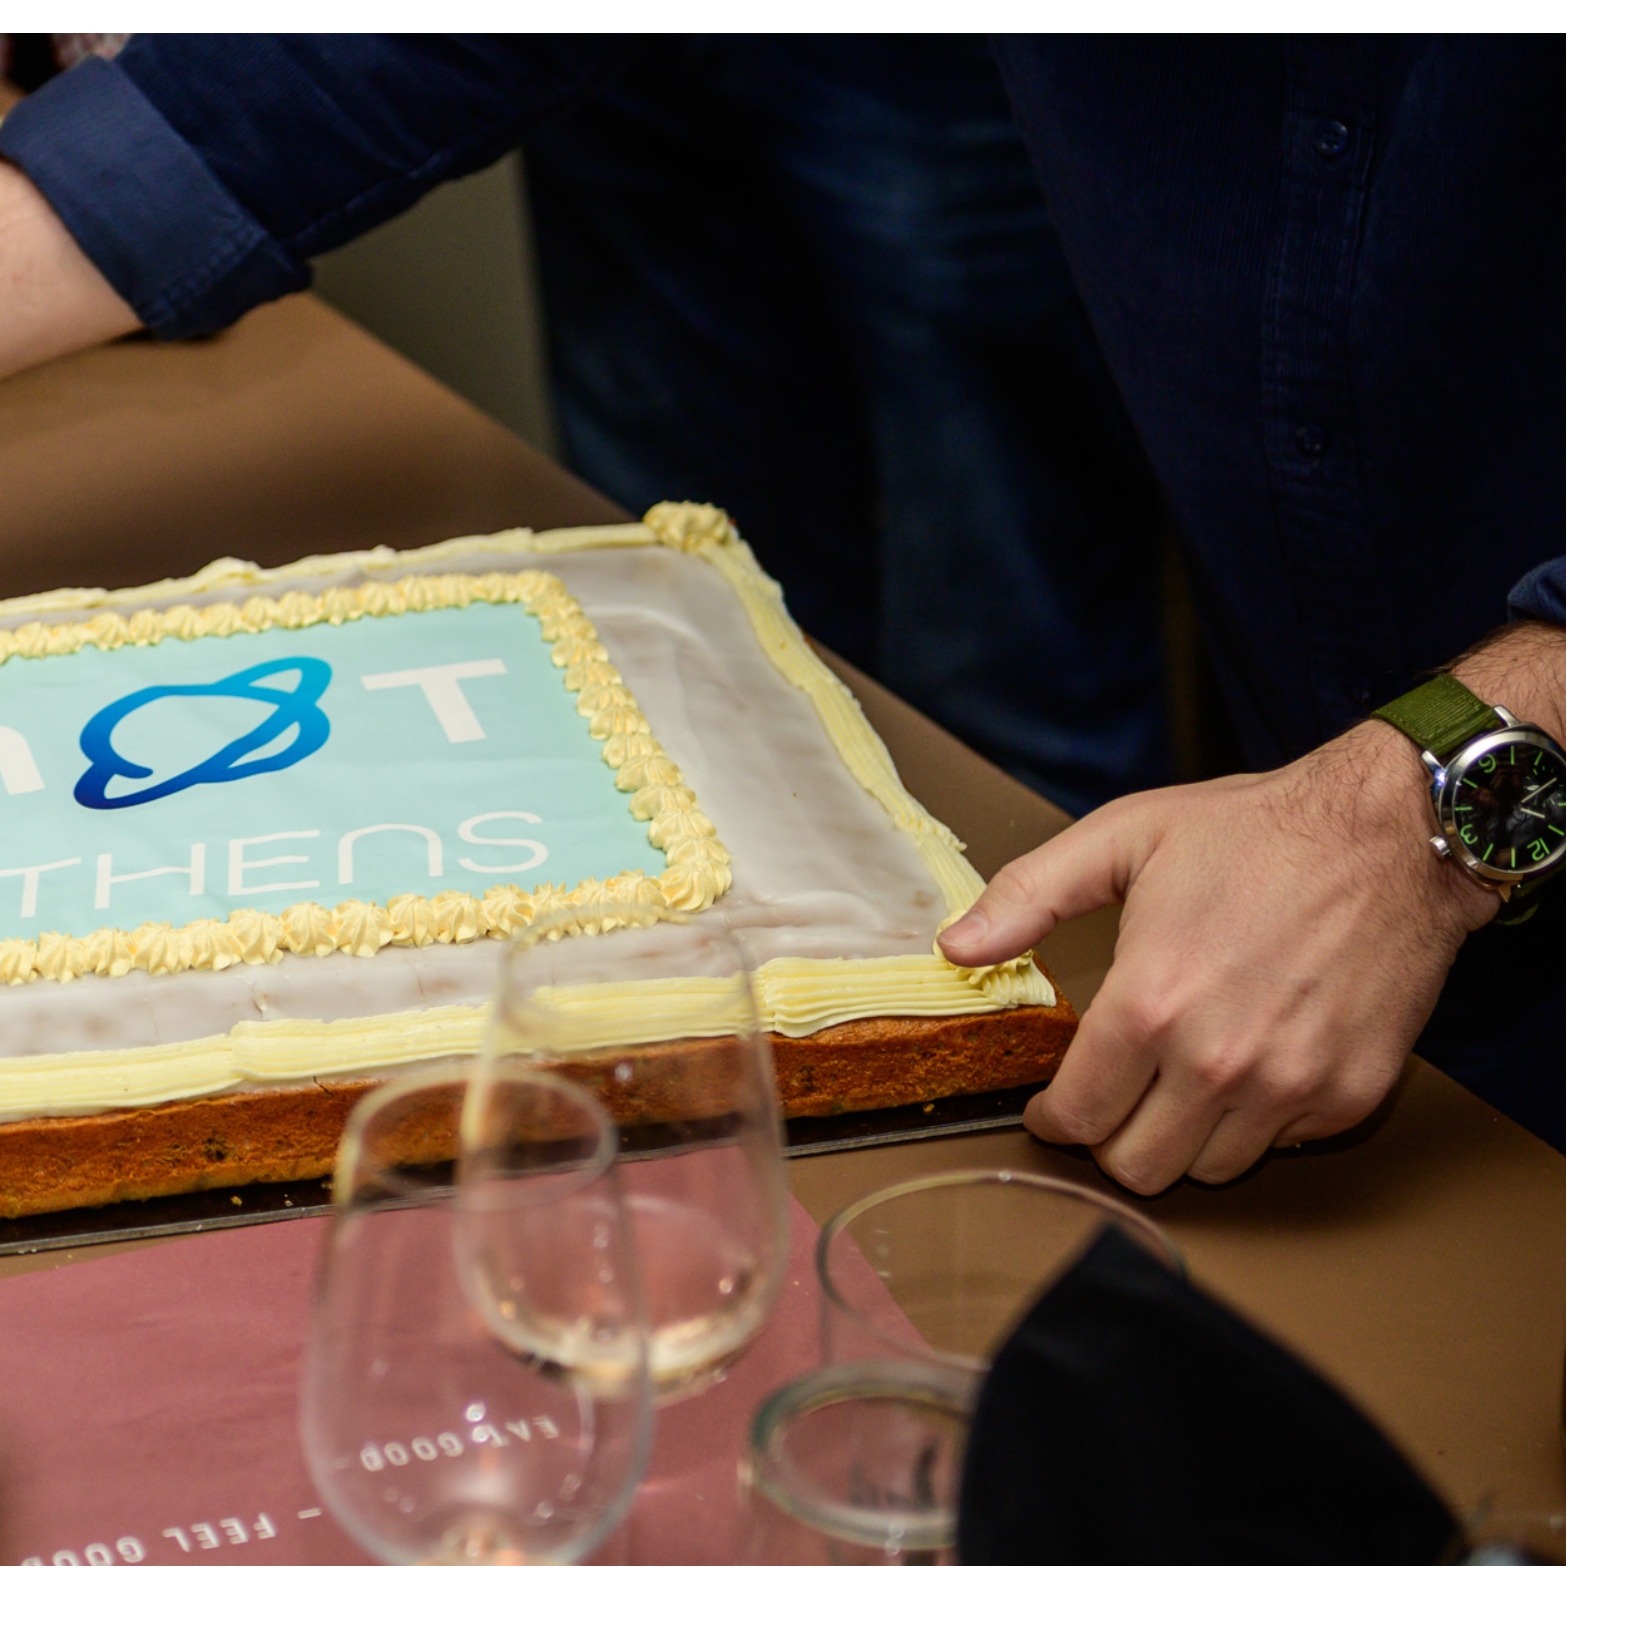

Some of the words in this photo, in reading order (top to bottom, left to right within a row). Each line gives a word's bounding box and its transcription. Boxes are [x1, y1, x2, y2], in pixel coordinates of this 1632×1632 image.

[1460, 824, 1478, 844] 3
[1526, 837, 1550, 861] 12
[359, 1431, 465, 1472] GOOD
[162, 1512, 276, 1553] FEEL
